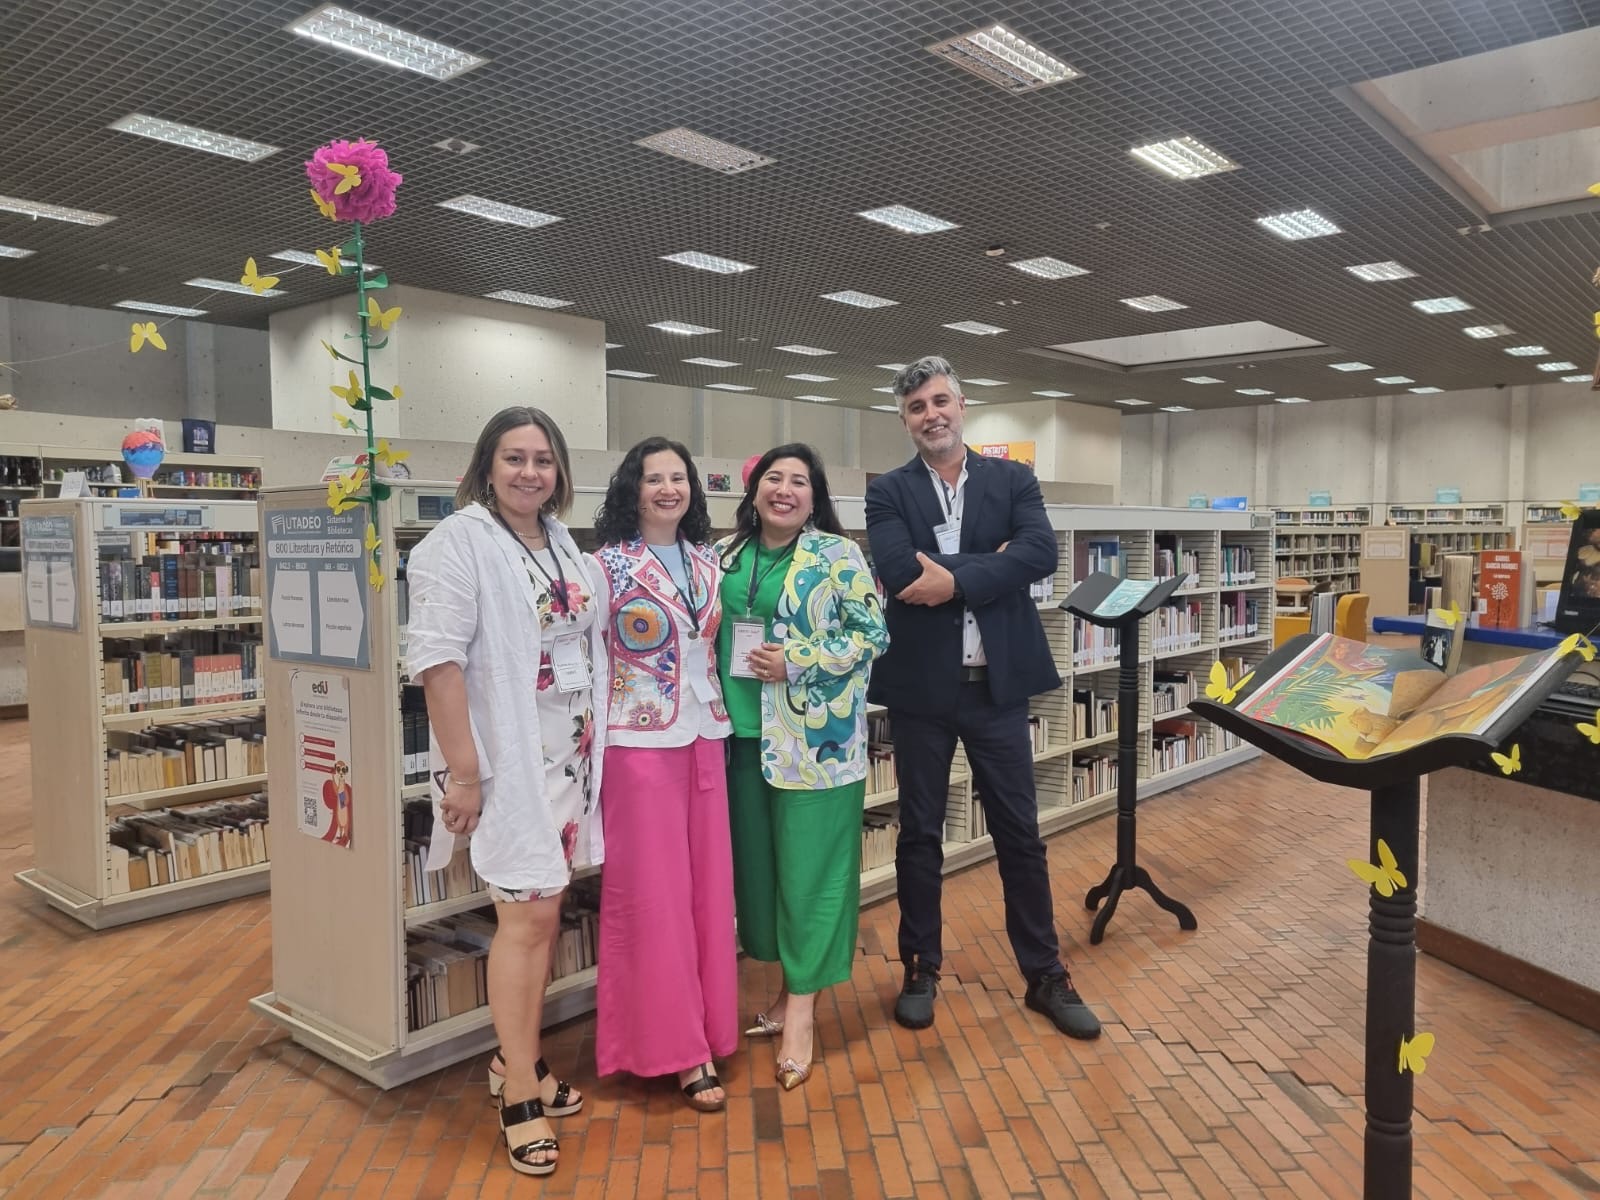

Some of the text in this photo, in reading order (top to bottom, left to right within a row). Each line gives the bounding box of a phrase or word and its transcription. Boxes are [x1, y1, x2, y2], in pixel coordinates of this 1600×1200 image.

[286, 515, 321, 530] UTADEO
[326, 515, 353, 524] Sistema de
[327, 526, 353, 535] Bibliotecas
[275, 541, 354, 557] 800 Literatura y Retórica
